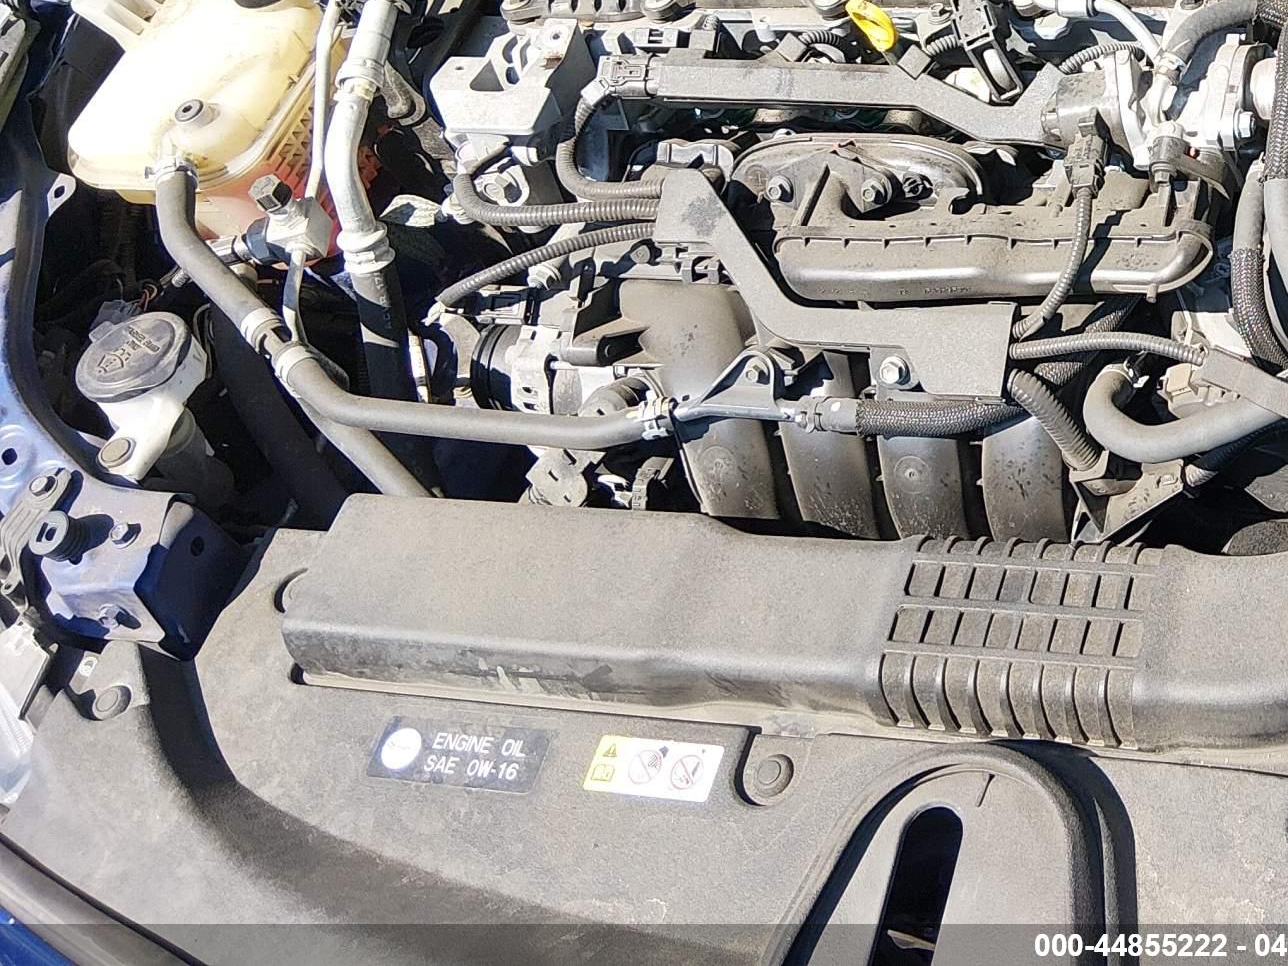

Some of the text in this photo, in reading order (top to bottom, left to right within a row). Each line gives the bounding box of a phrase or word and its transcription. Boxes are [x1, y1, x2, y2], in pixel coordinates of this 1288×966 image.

[432, 732, 526, 757] ENGINE OIL
[424, 755, 460, 774] SAE
